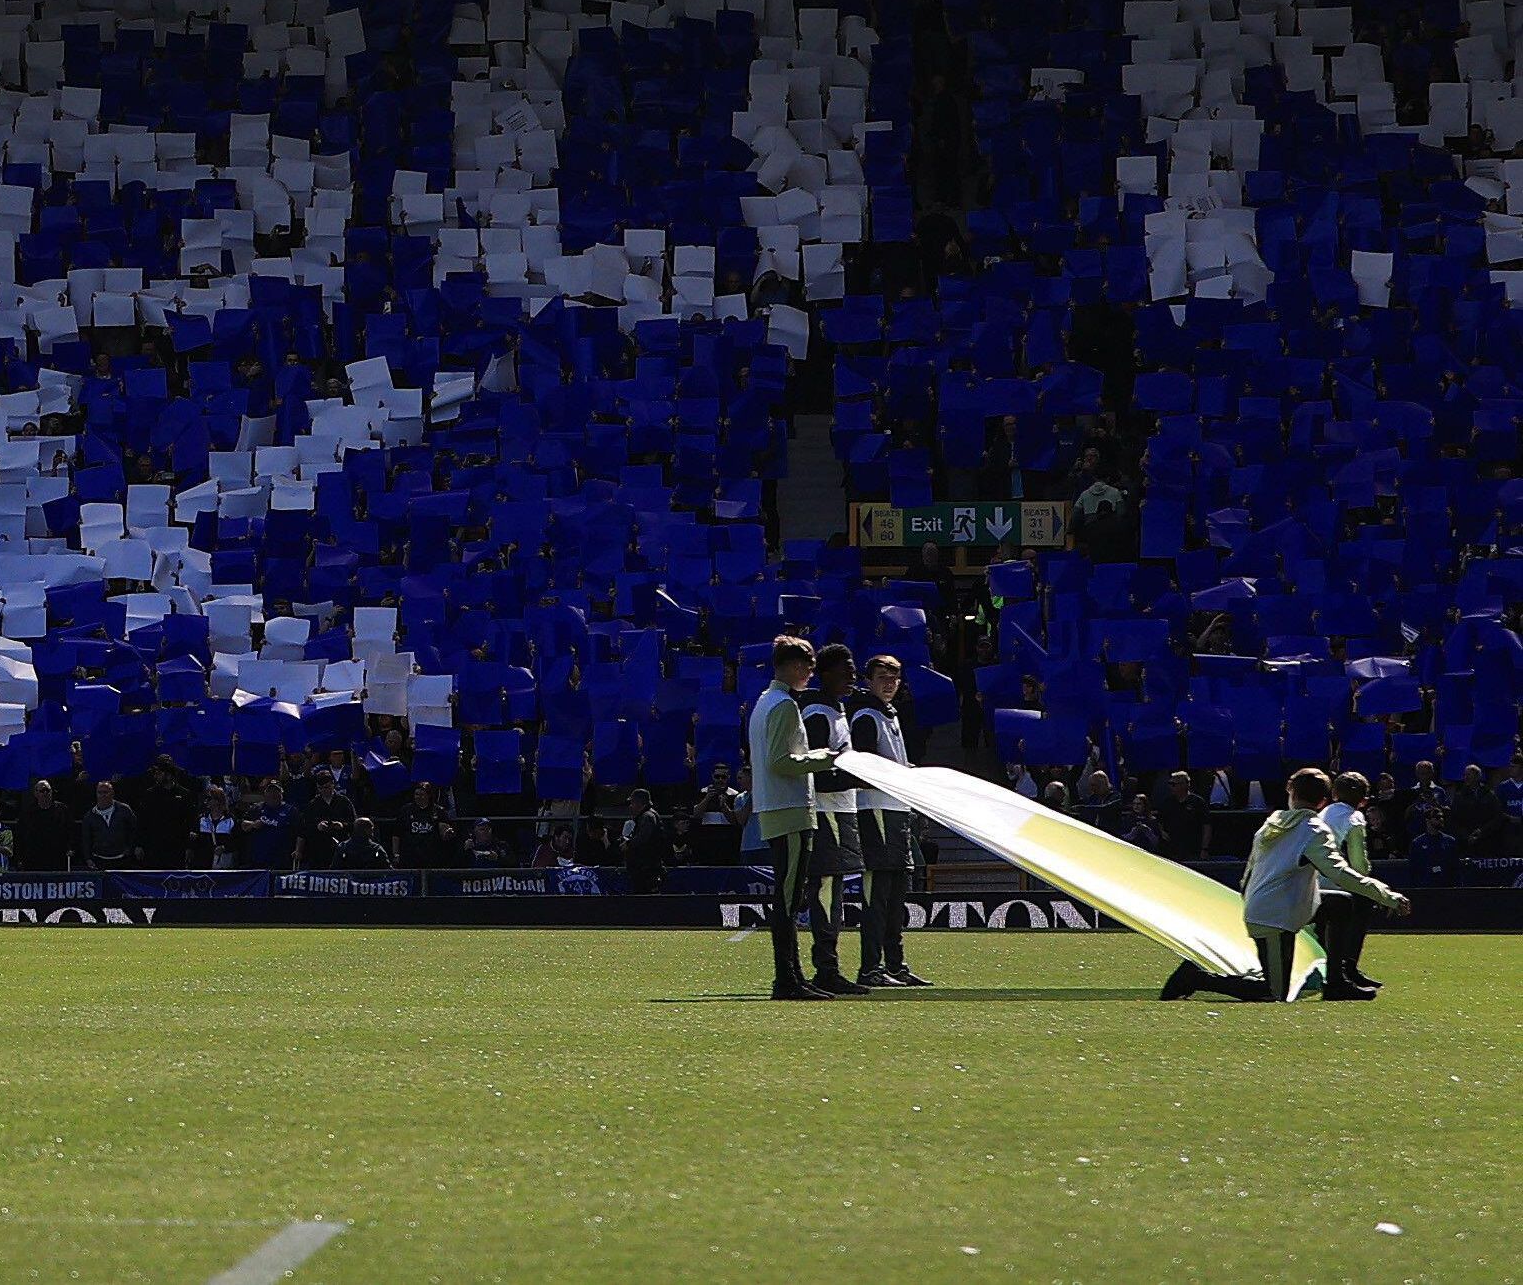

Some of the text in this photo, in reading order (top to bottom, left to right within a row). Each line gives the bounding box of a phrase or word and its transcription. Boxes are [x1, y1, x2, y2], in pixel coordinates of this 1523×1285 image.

[911, 517, 943, 532] Exit
[47, 880, 96, 899] BLUES
[280, 874, 409, 898] THE IRISH TOFFEES
[462, 877, 547, 895] NORWEGIAN
